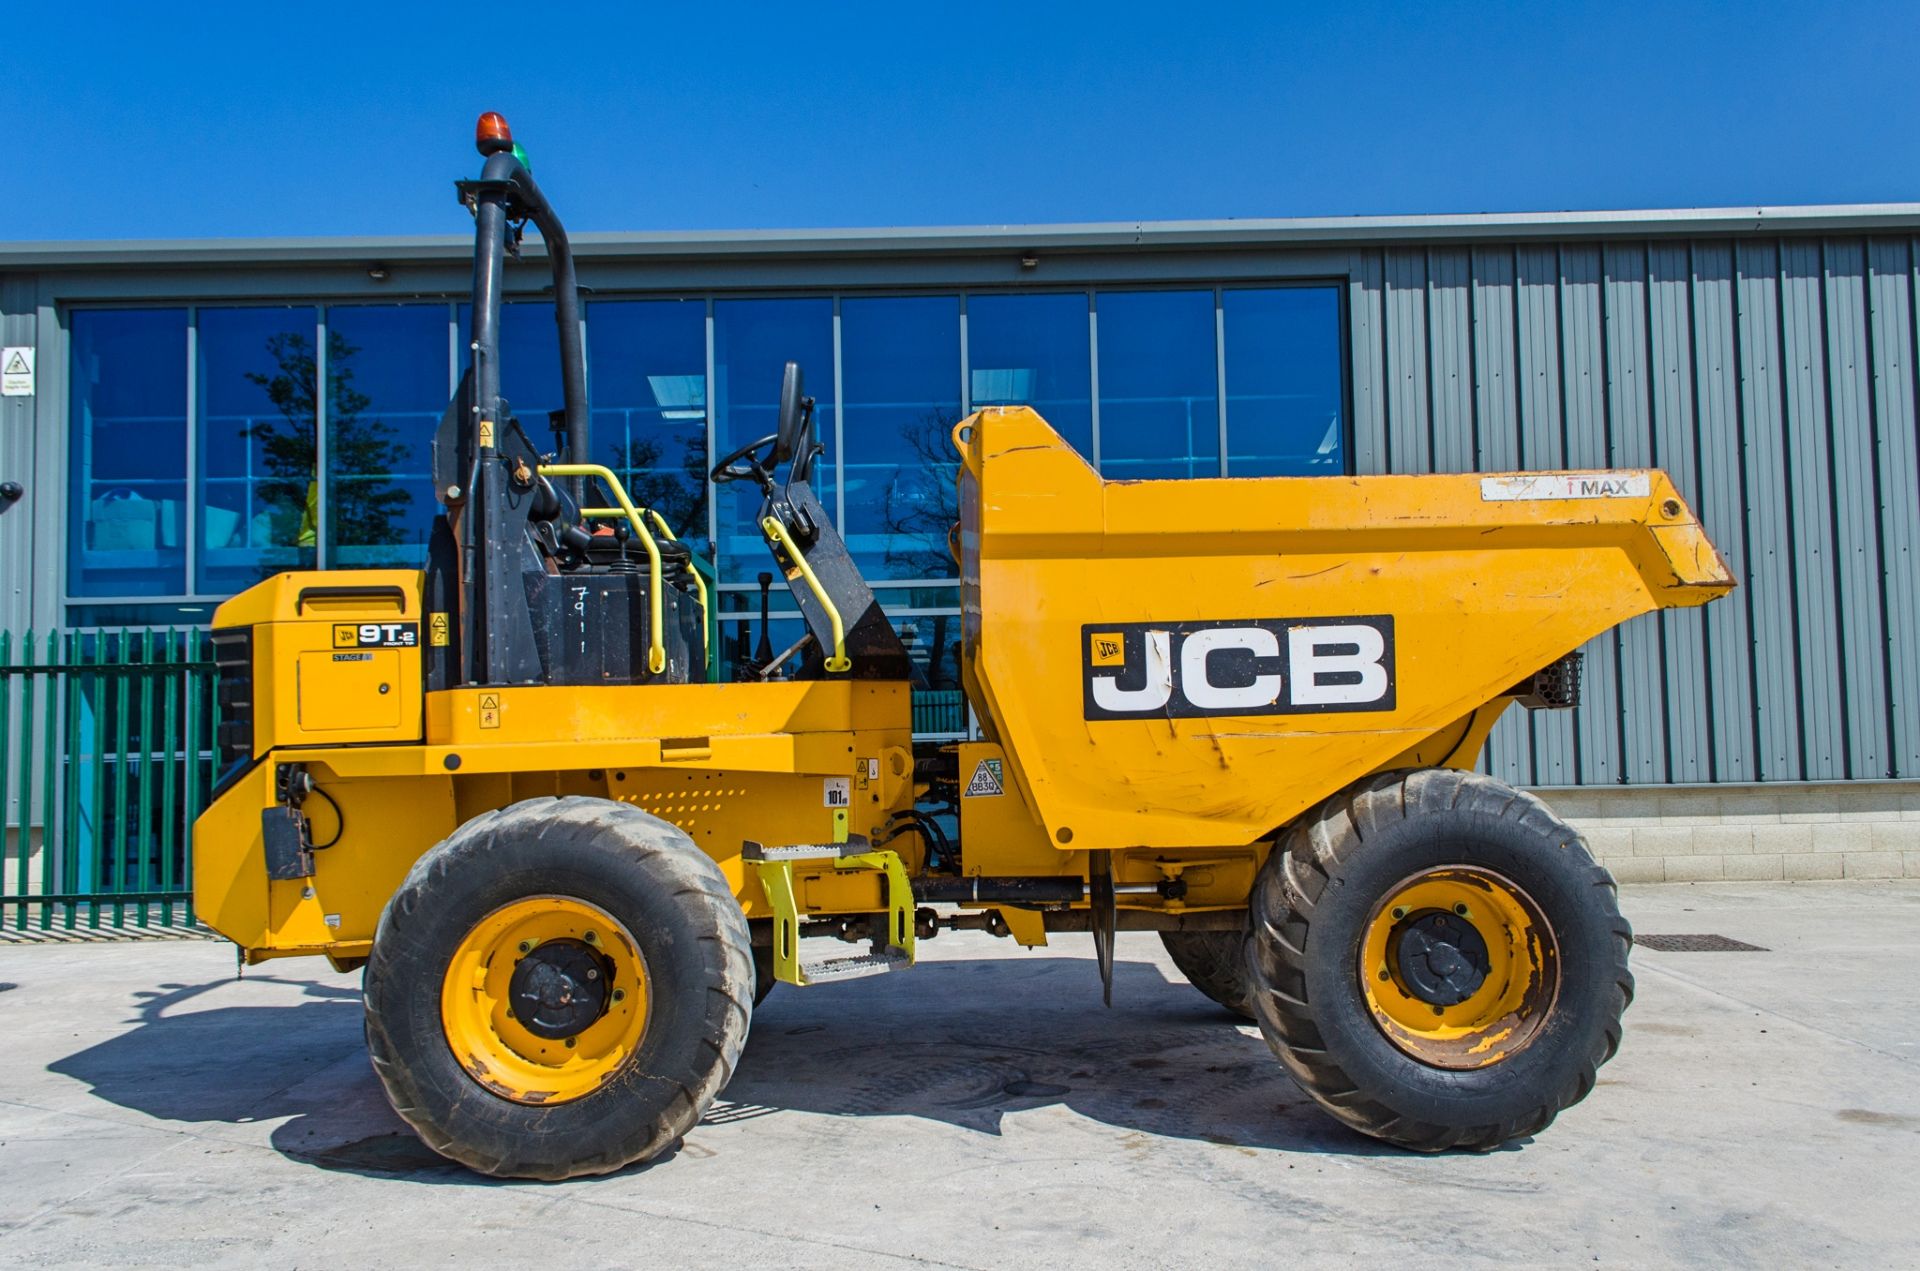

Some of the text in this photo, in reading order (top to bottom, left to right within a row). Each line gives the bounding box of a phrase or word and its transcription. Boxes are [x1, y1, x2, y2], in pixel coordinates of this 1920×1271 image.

[1581, 480, 1629, 495] MAX
[1100, 642, 1119, 657] JCB
[1092, 624, 1388, 712] JCB
[828, 790, 842, 804] 101
